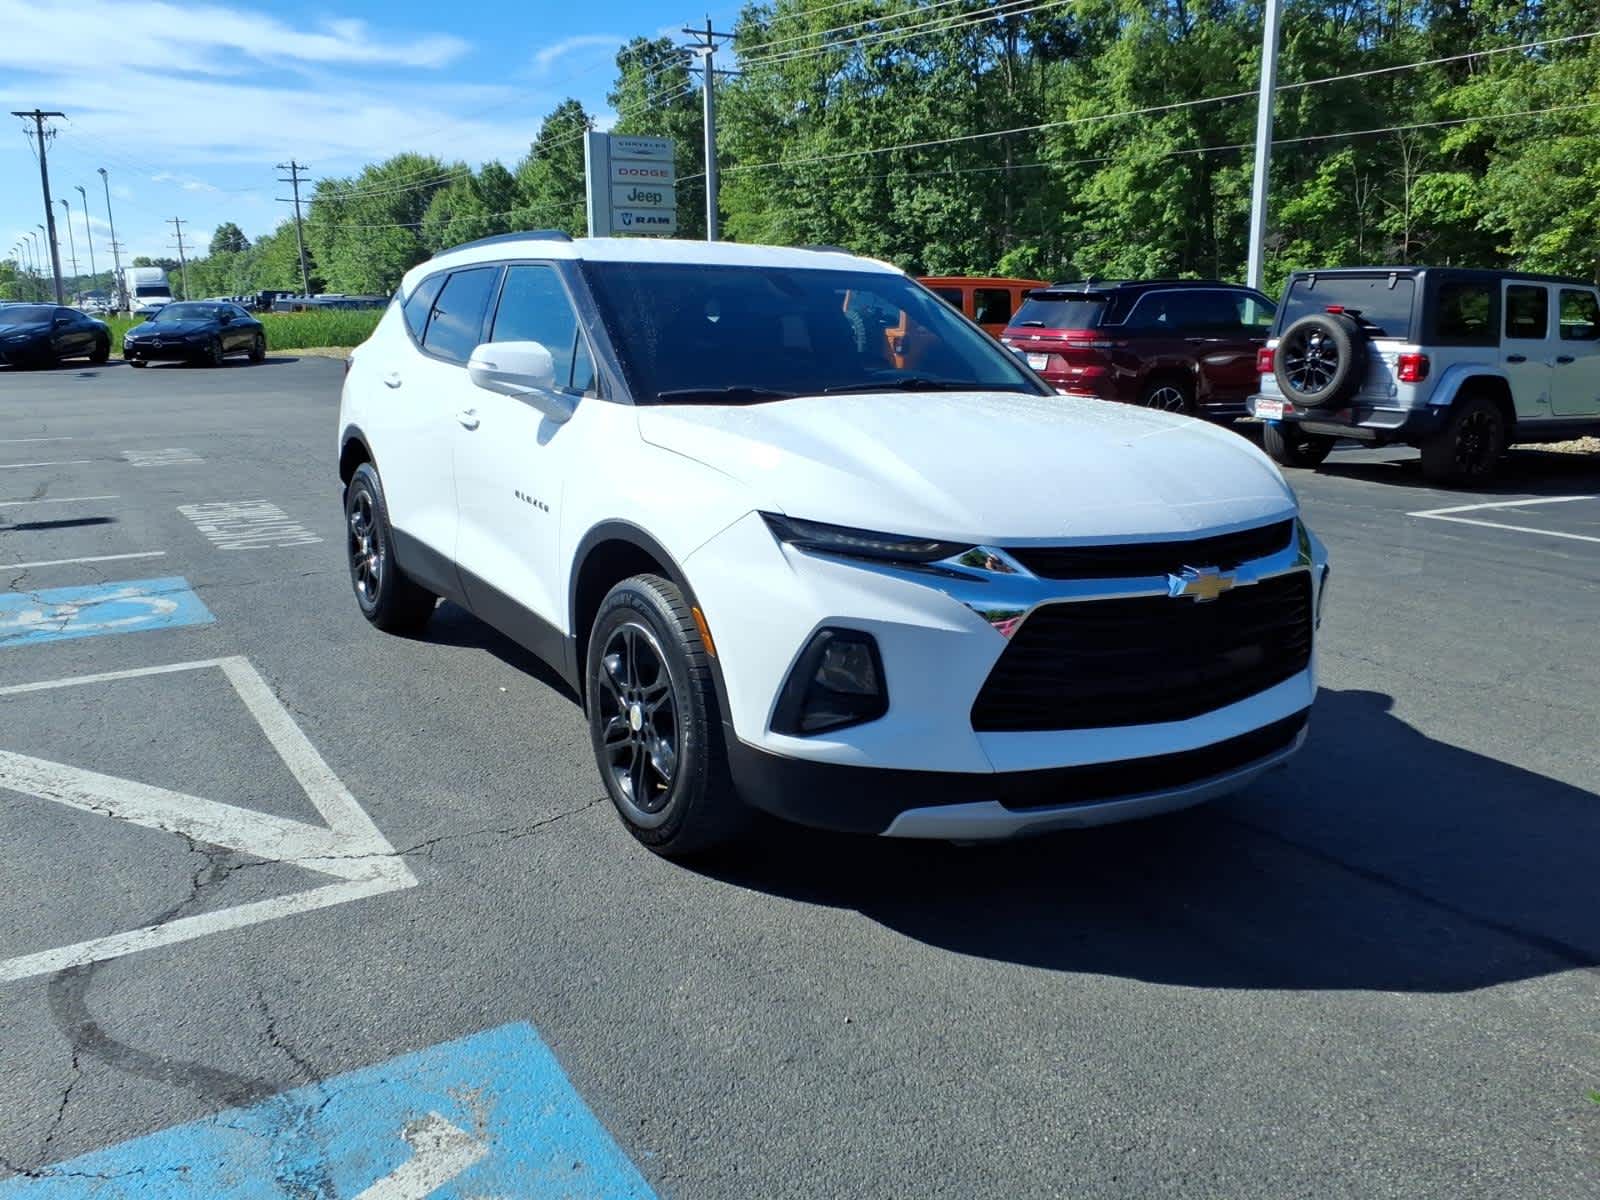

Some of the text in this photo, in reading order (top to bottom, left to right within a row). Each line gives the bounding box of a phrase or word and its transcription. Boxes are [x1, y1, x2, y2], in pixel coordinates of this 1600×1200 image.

[618, 168, 669, 177] DODGE
[627, 187, 662, 205] Jeep
[635, 216, 670, 225] RAM
